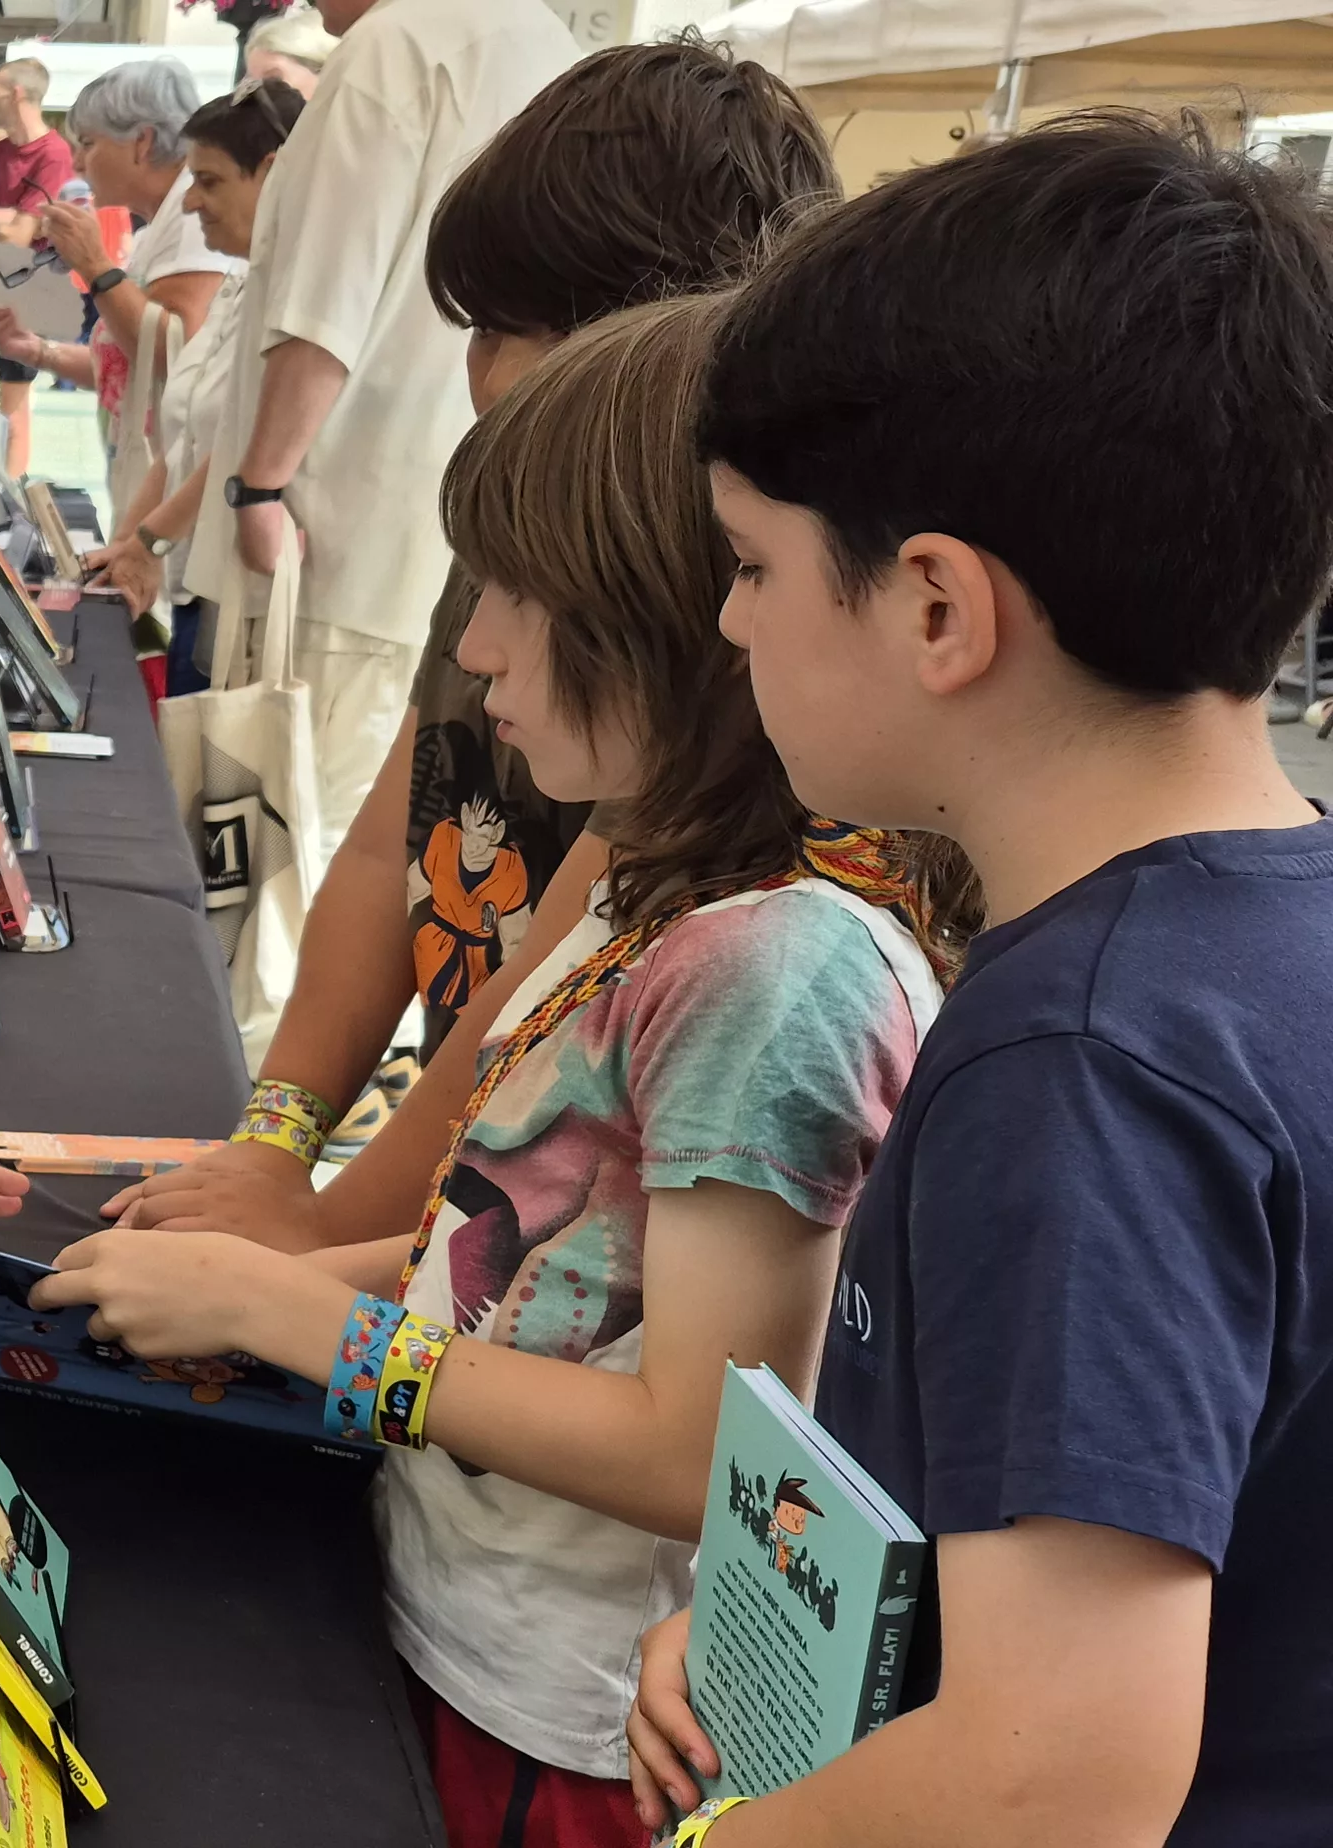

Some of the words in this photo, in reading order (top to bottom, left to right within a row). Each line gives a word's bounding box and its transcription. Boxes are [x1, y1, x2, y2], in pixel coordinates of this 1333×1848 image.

[894, 1568, 908, 1585] 1
[878, 1627, 901, 1677] FLAT!
[871, 1682, 891, 1711] SR.
